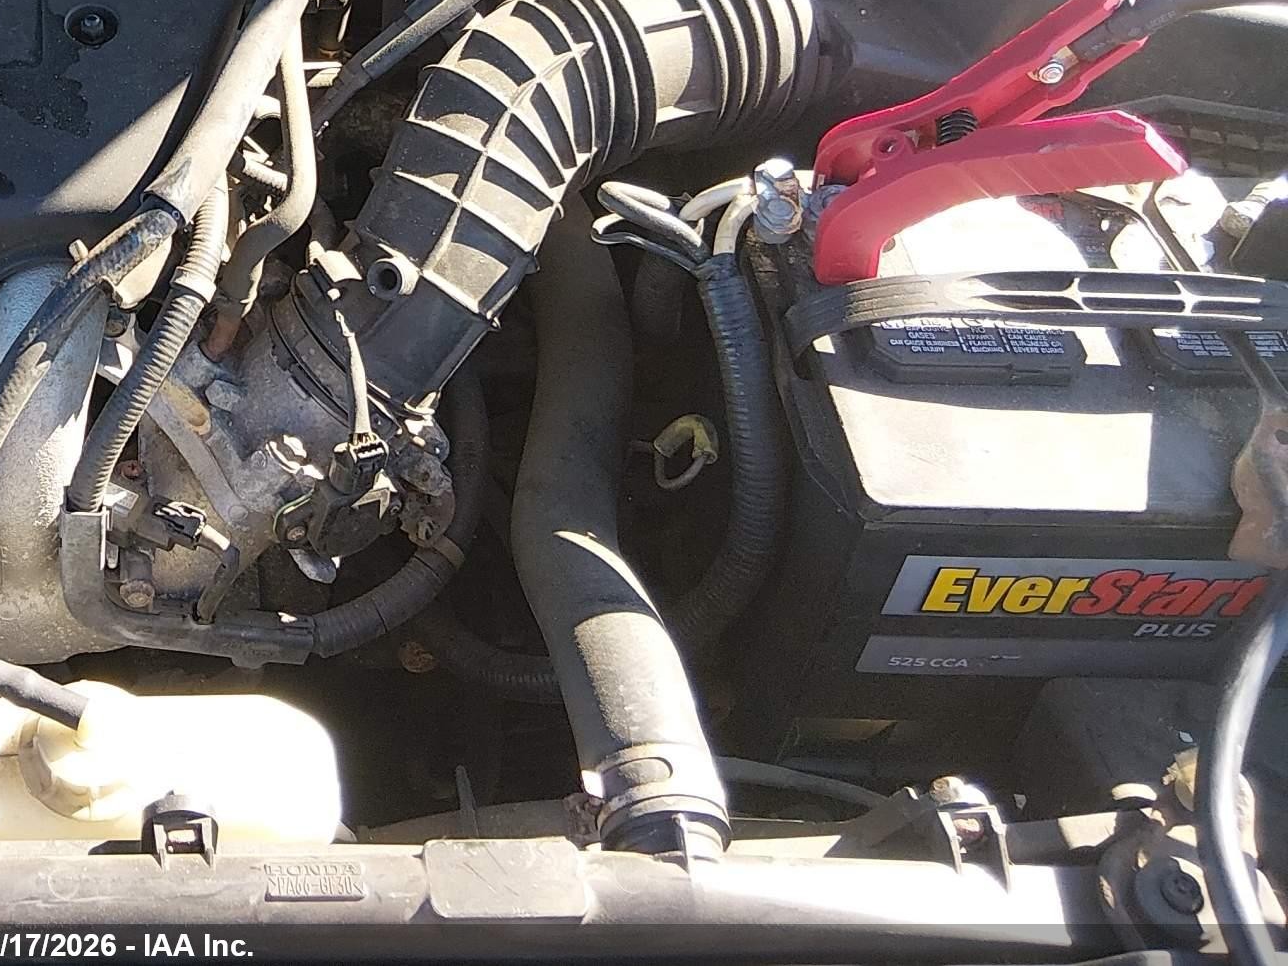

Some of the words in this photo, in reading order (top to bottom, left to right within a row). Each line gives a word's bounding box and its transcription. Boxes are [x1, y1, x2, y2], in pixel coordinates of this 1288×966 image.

[920, 566, 1271, 618] EverStart
[1133, 622, 1217, 638] PLUS
[887, 656, 927, 668] 525
[929, 657, 969, 669] CCA
[262, 863, 362, 875] HONDA
